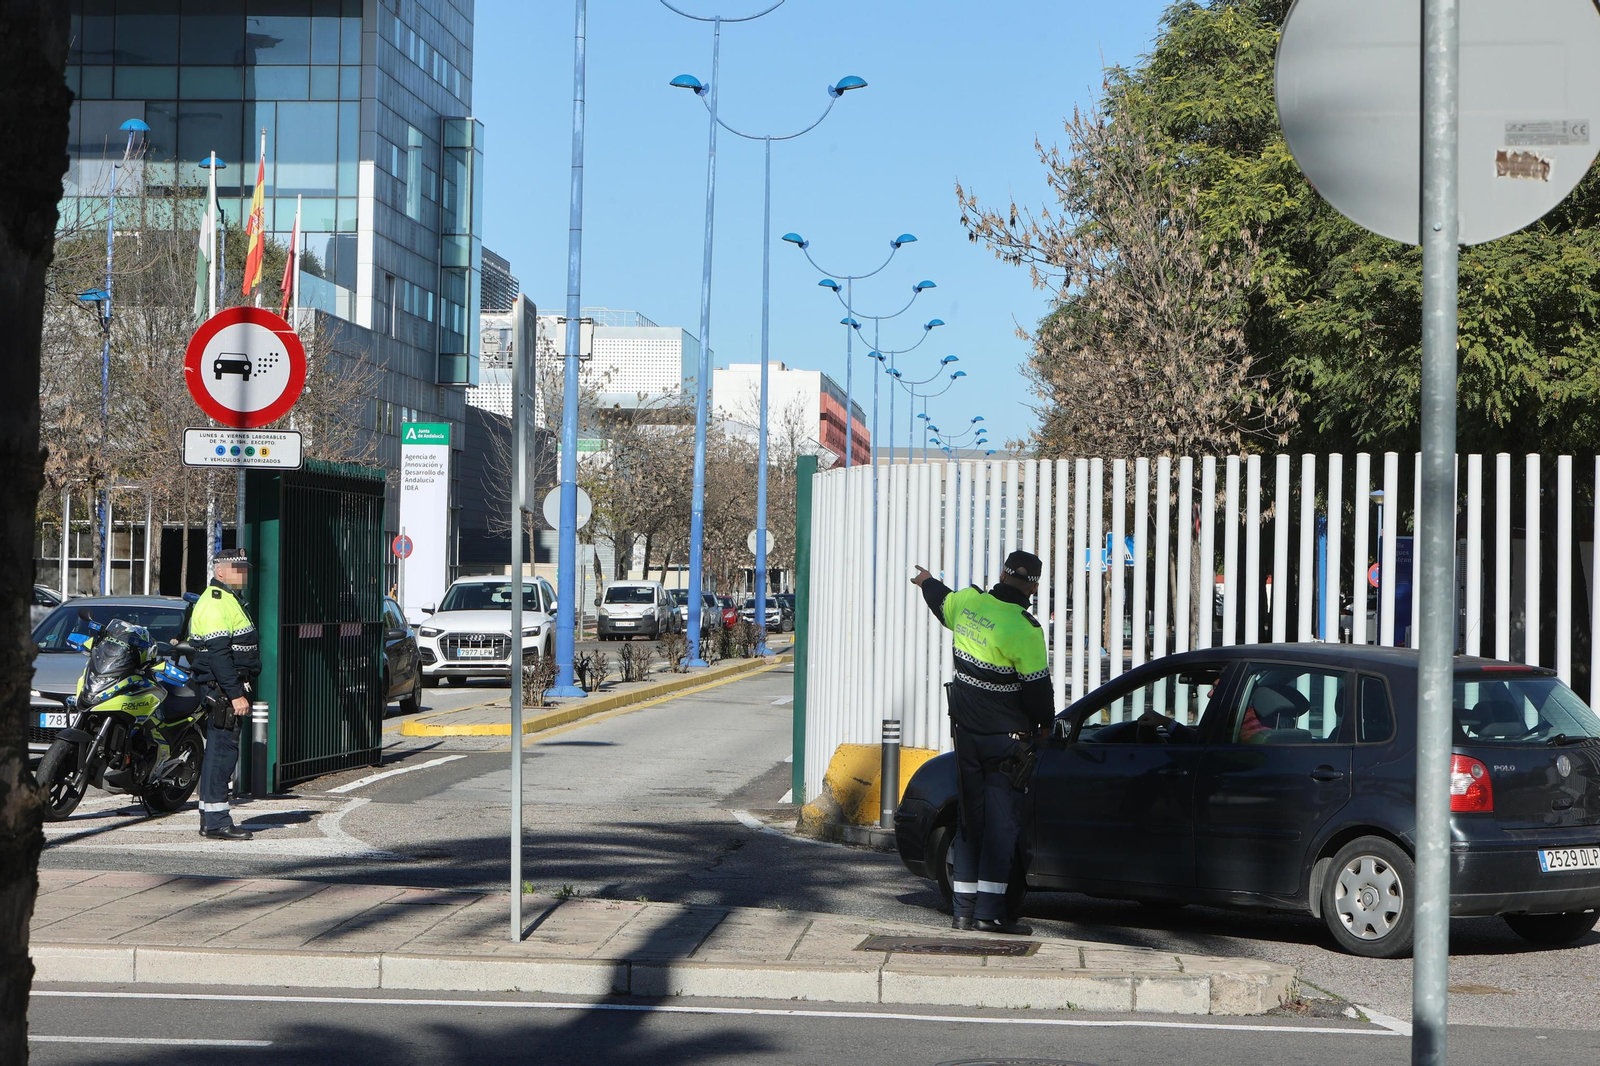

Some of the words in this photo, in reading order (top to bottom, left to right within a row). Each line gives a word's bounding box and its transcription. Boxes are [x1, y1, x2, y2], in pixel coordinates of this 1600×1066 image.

[965, 621, 982, 633] LOCAL
[955, 623, 987, 647] SEVILLA
[1493, 764, 1516, 772] POLO
[1547, 849, 1579, 868] 2529
[1579, 849, 1599, 866] DLP
